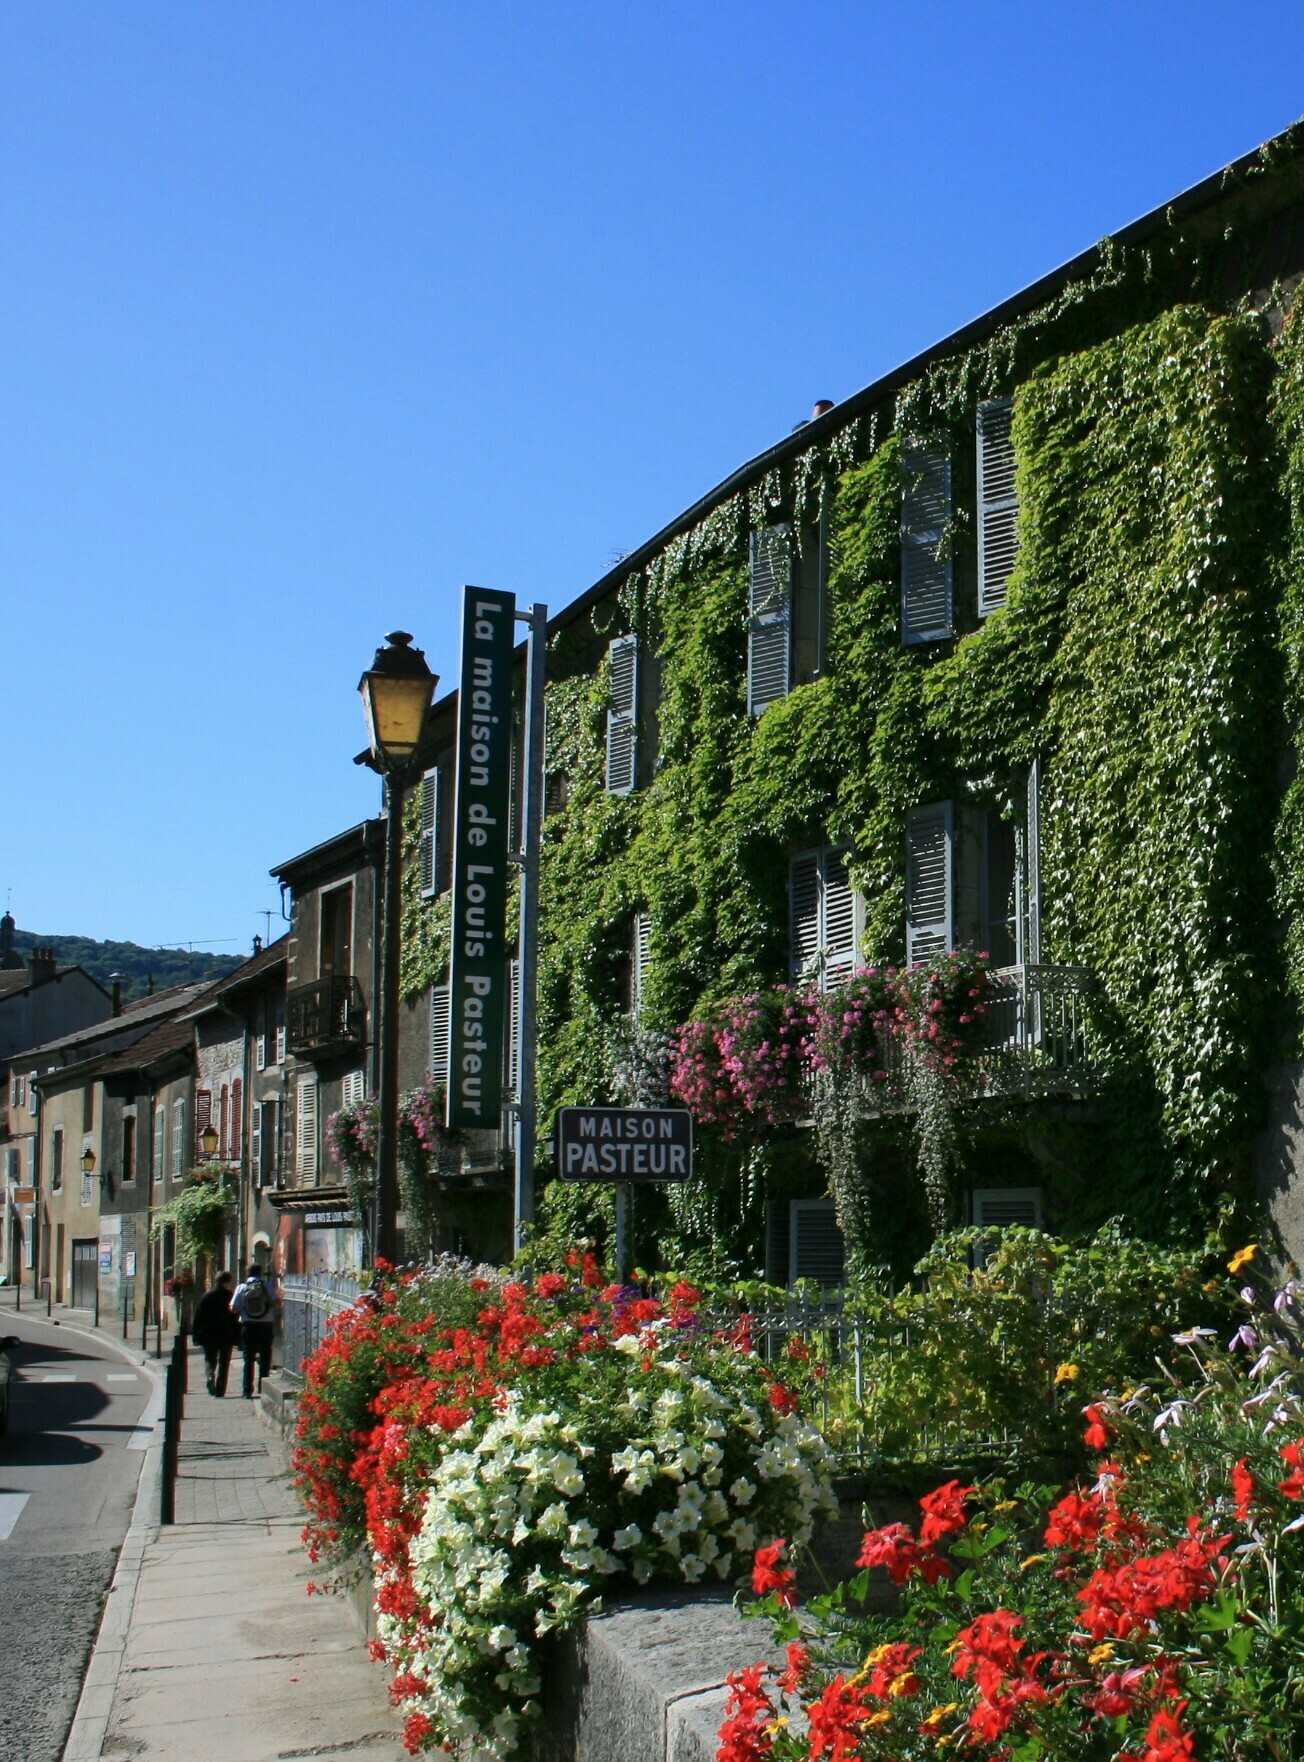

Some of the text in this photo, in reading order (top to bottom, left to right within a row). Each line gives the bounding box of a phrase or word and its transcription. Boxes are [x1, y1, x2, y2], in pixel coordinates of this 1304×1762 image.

[462, 601, 502, 1115] La maison de Louis Pasteur
[580, 1117, 673, 1138] MAISON
[566, 1143, 686, 1173] PASTEUR
